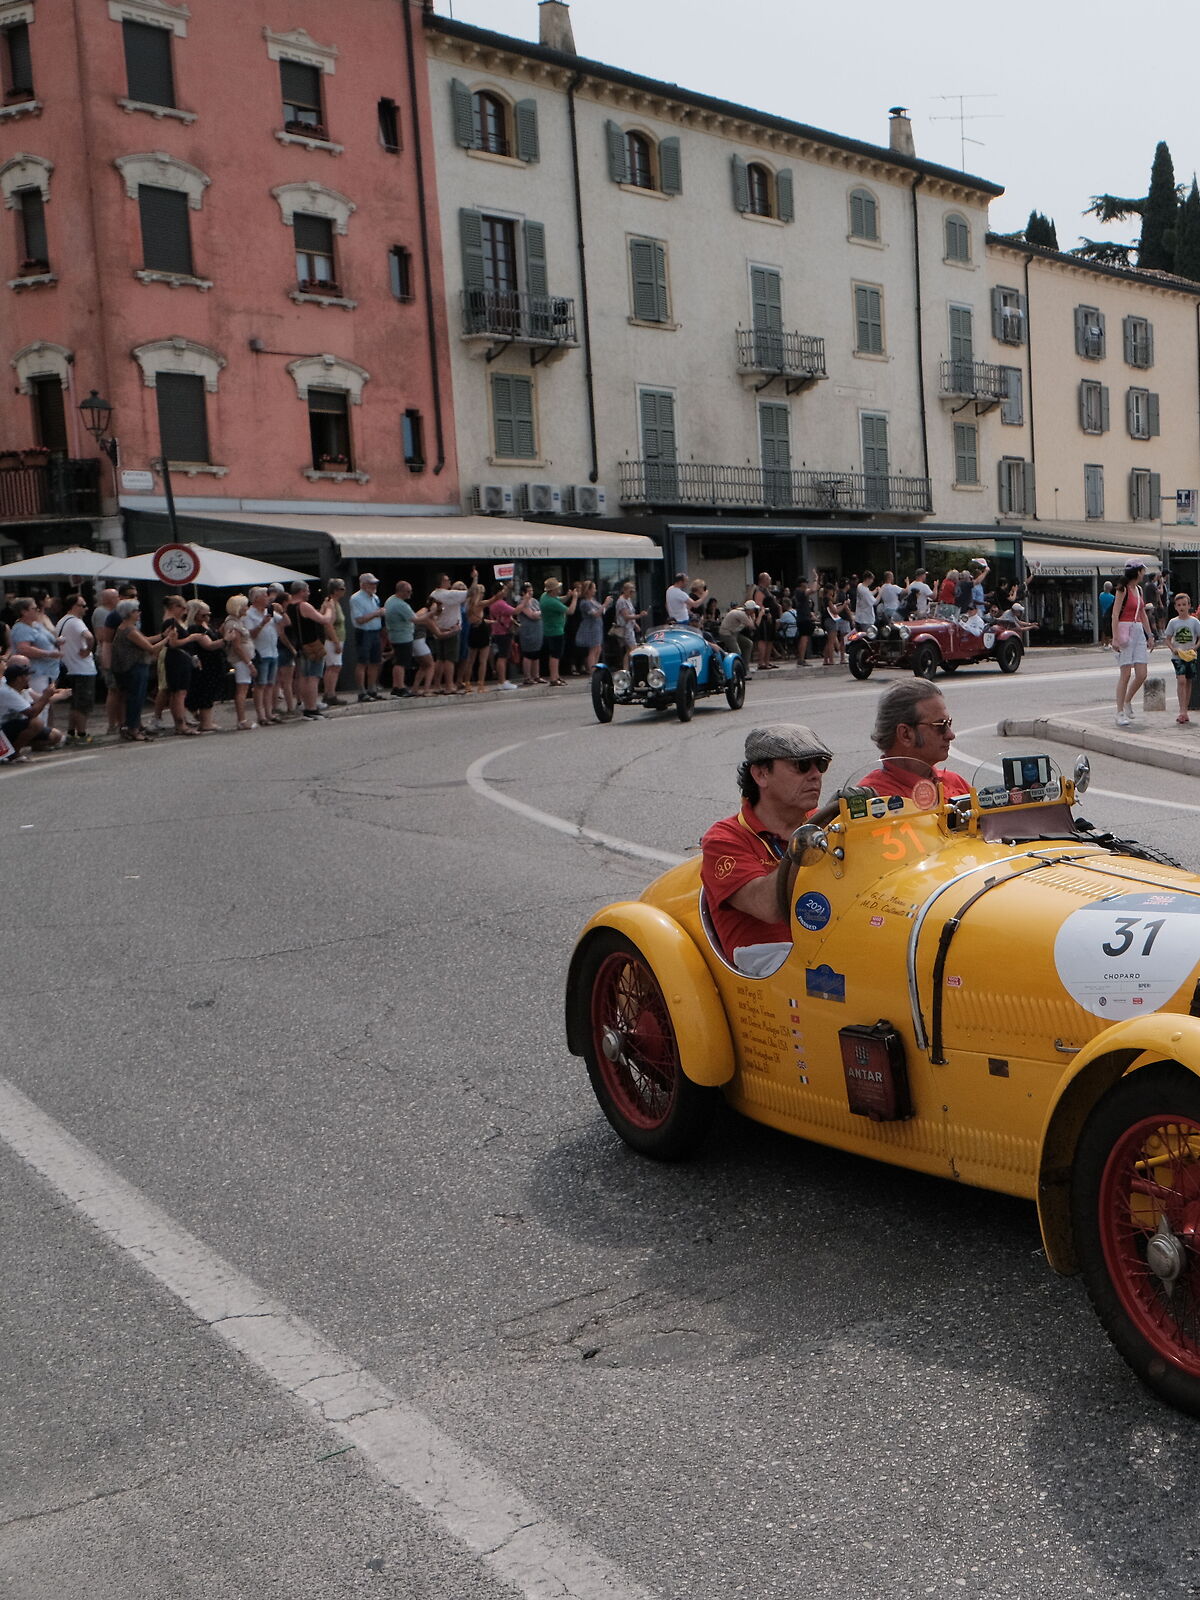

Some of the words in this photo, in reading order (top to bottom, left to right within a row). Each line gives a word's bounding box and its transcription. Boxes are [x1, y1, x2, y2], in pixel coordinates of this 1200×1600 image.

[492, 546, 549, 556] CARDUCCI
[1063, 566, 1093, 576] Souvenirs
[653, 632, 665, 641] 22
[872, 822, 926, 861] 31
[717, 858, 732, 877] 36
[806, 899, 825, 917] 2021
[1102, 917, 1167, 957] 31
[848, 1067, 883, 1083] ANTAR
